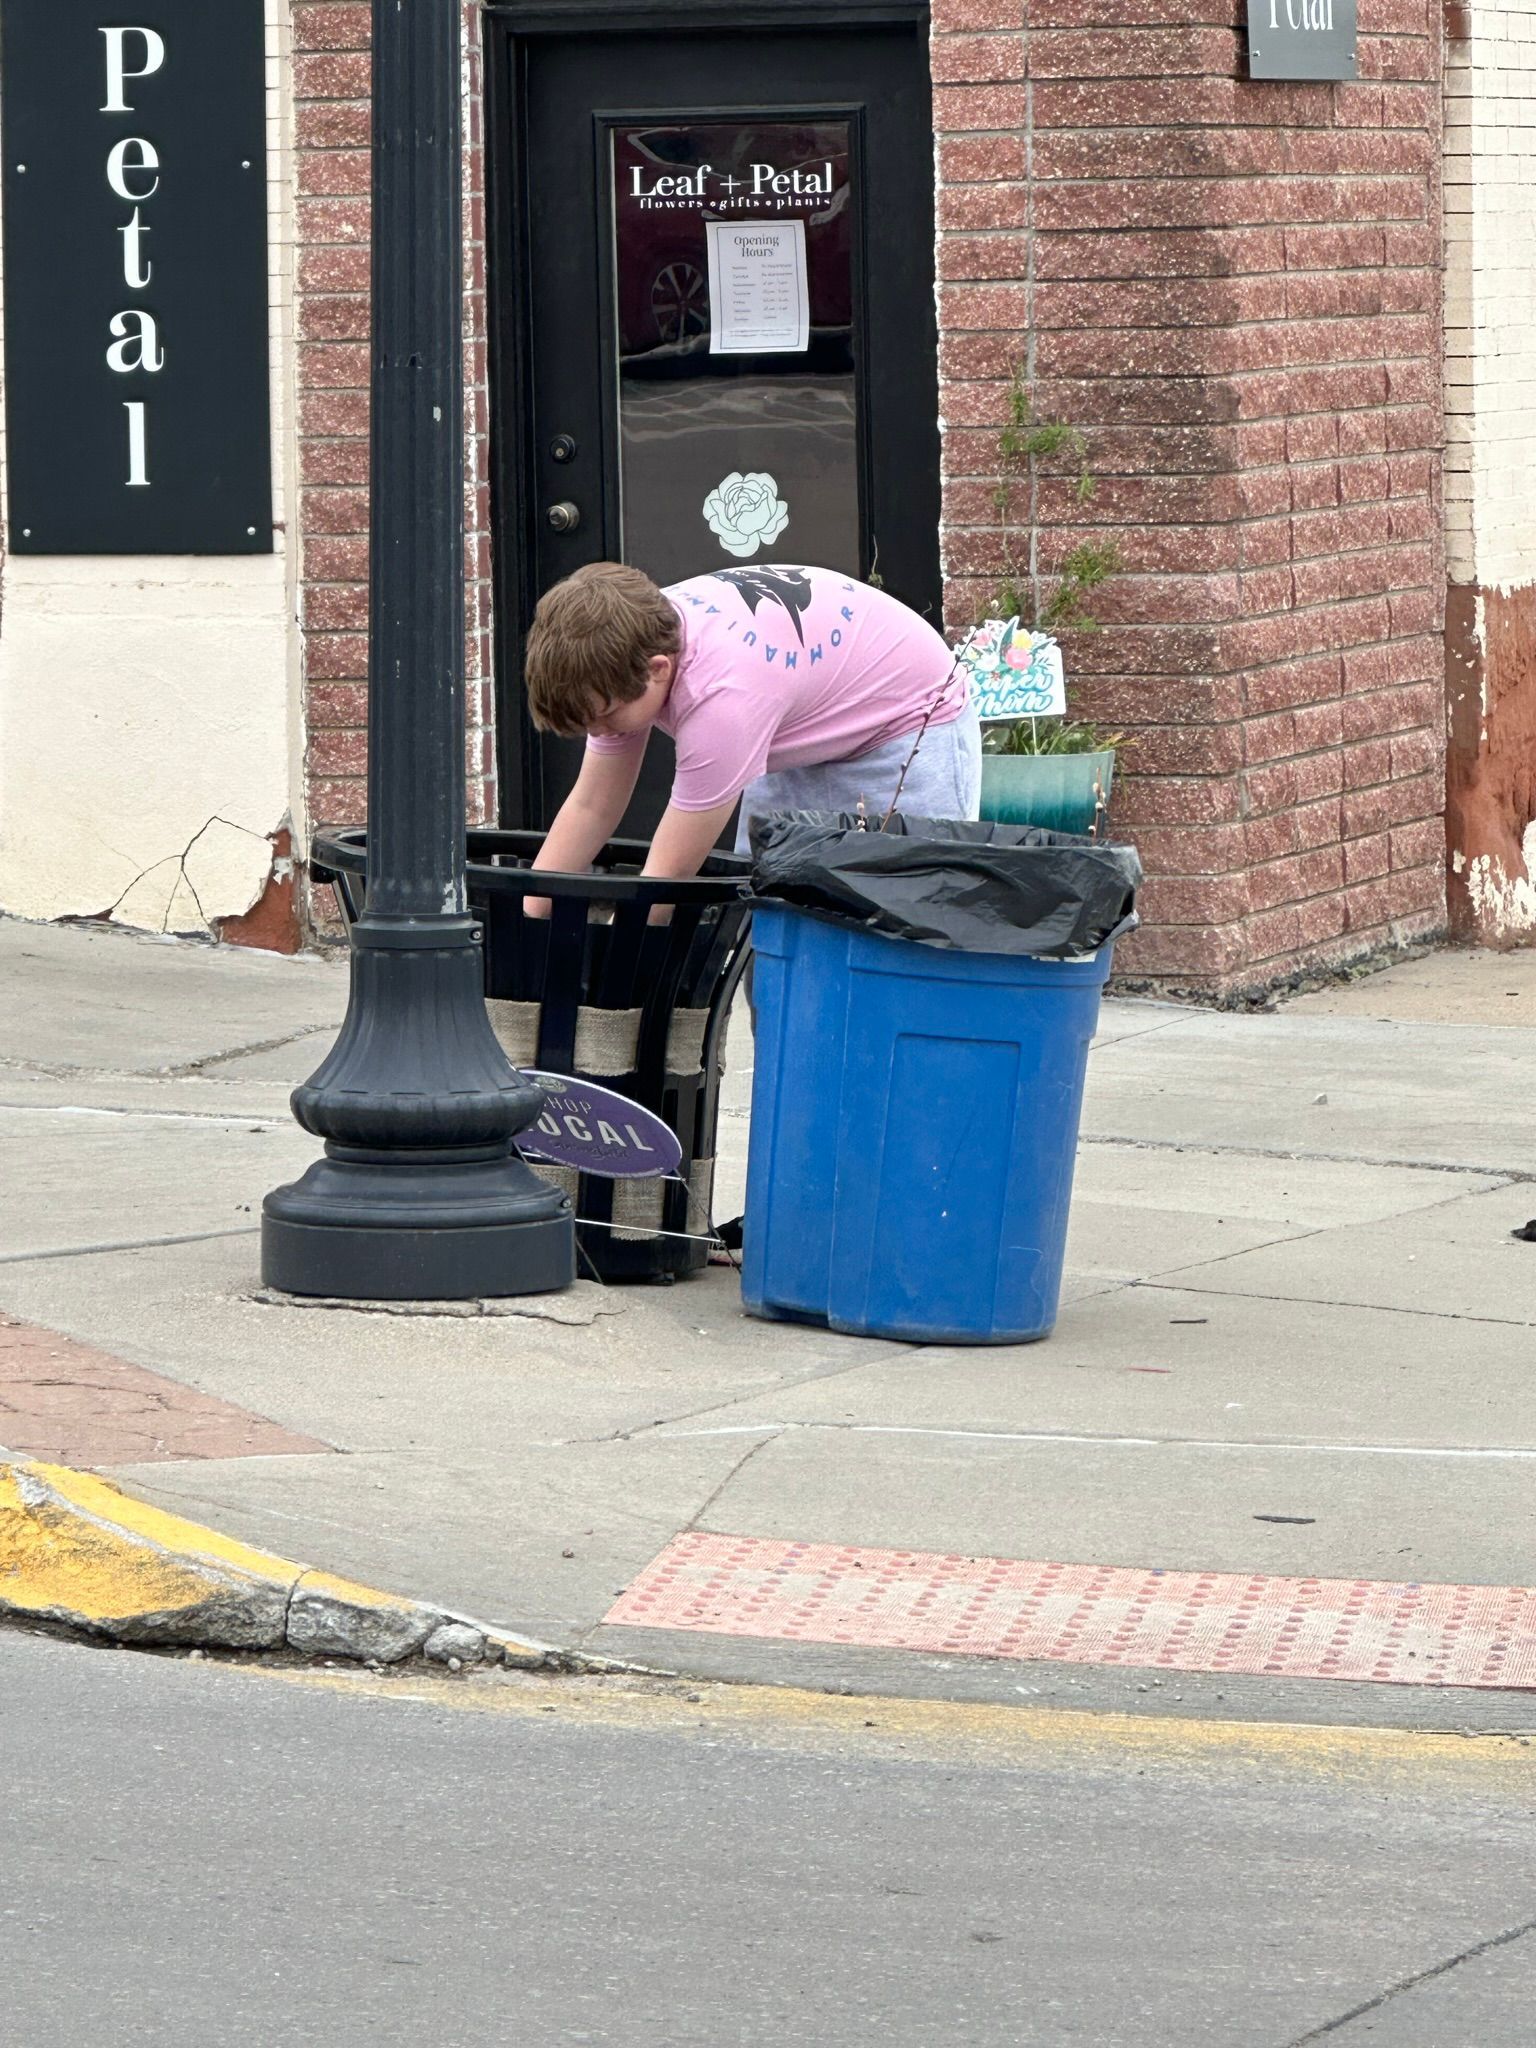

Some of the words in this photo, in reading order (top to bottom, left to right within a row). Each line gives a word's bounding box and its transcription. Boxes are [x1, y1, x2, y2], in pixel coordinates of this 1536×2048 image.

[629, 165, 712, 196] Leaf
[750, 163, 832, 195] Petal
[734, 233, 780, 247] Opening
[741, 247, 774, 257] Hours
[98, 27, 165, 486] Petal
[544, 1096, 592, 1115] HOP
[536, 1112, 654, 1152] OCAL
